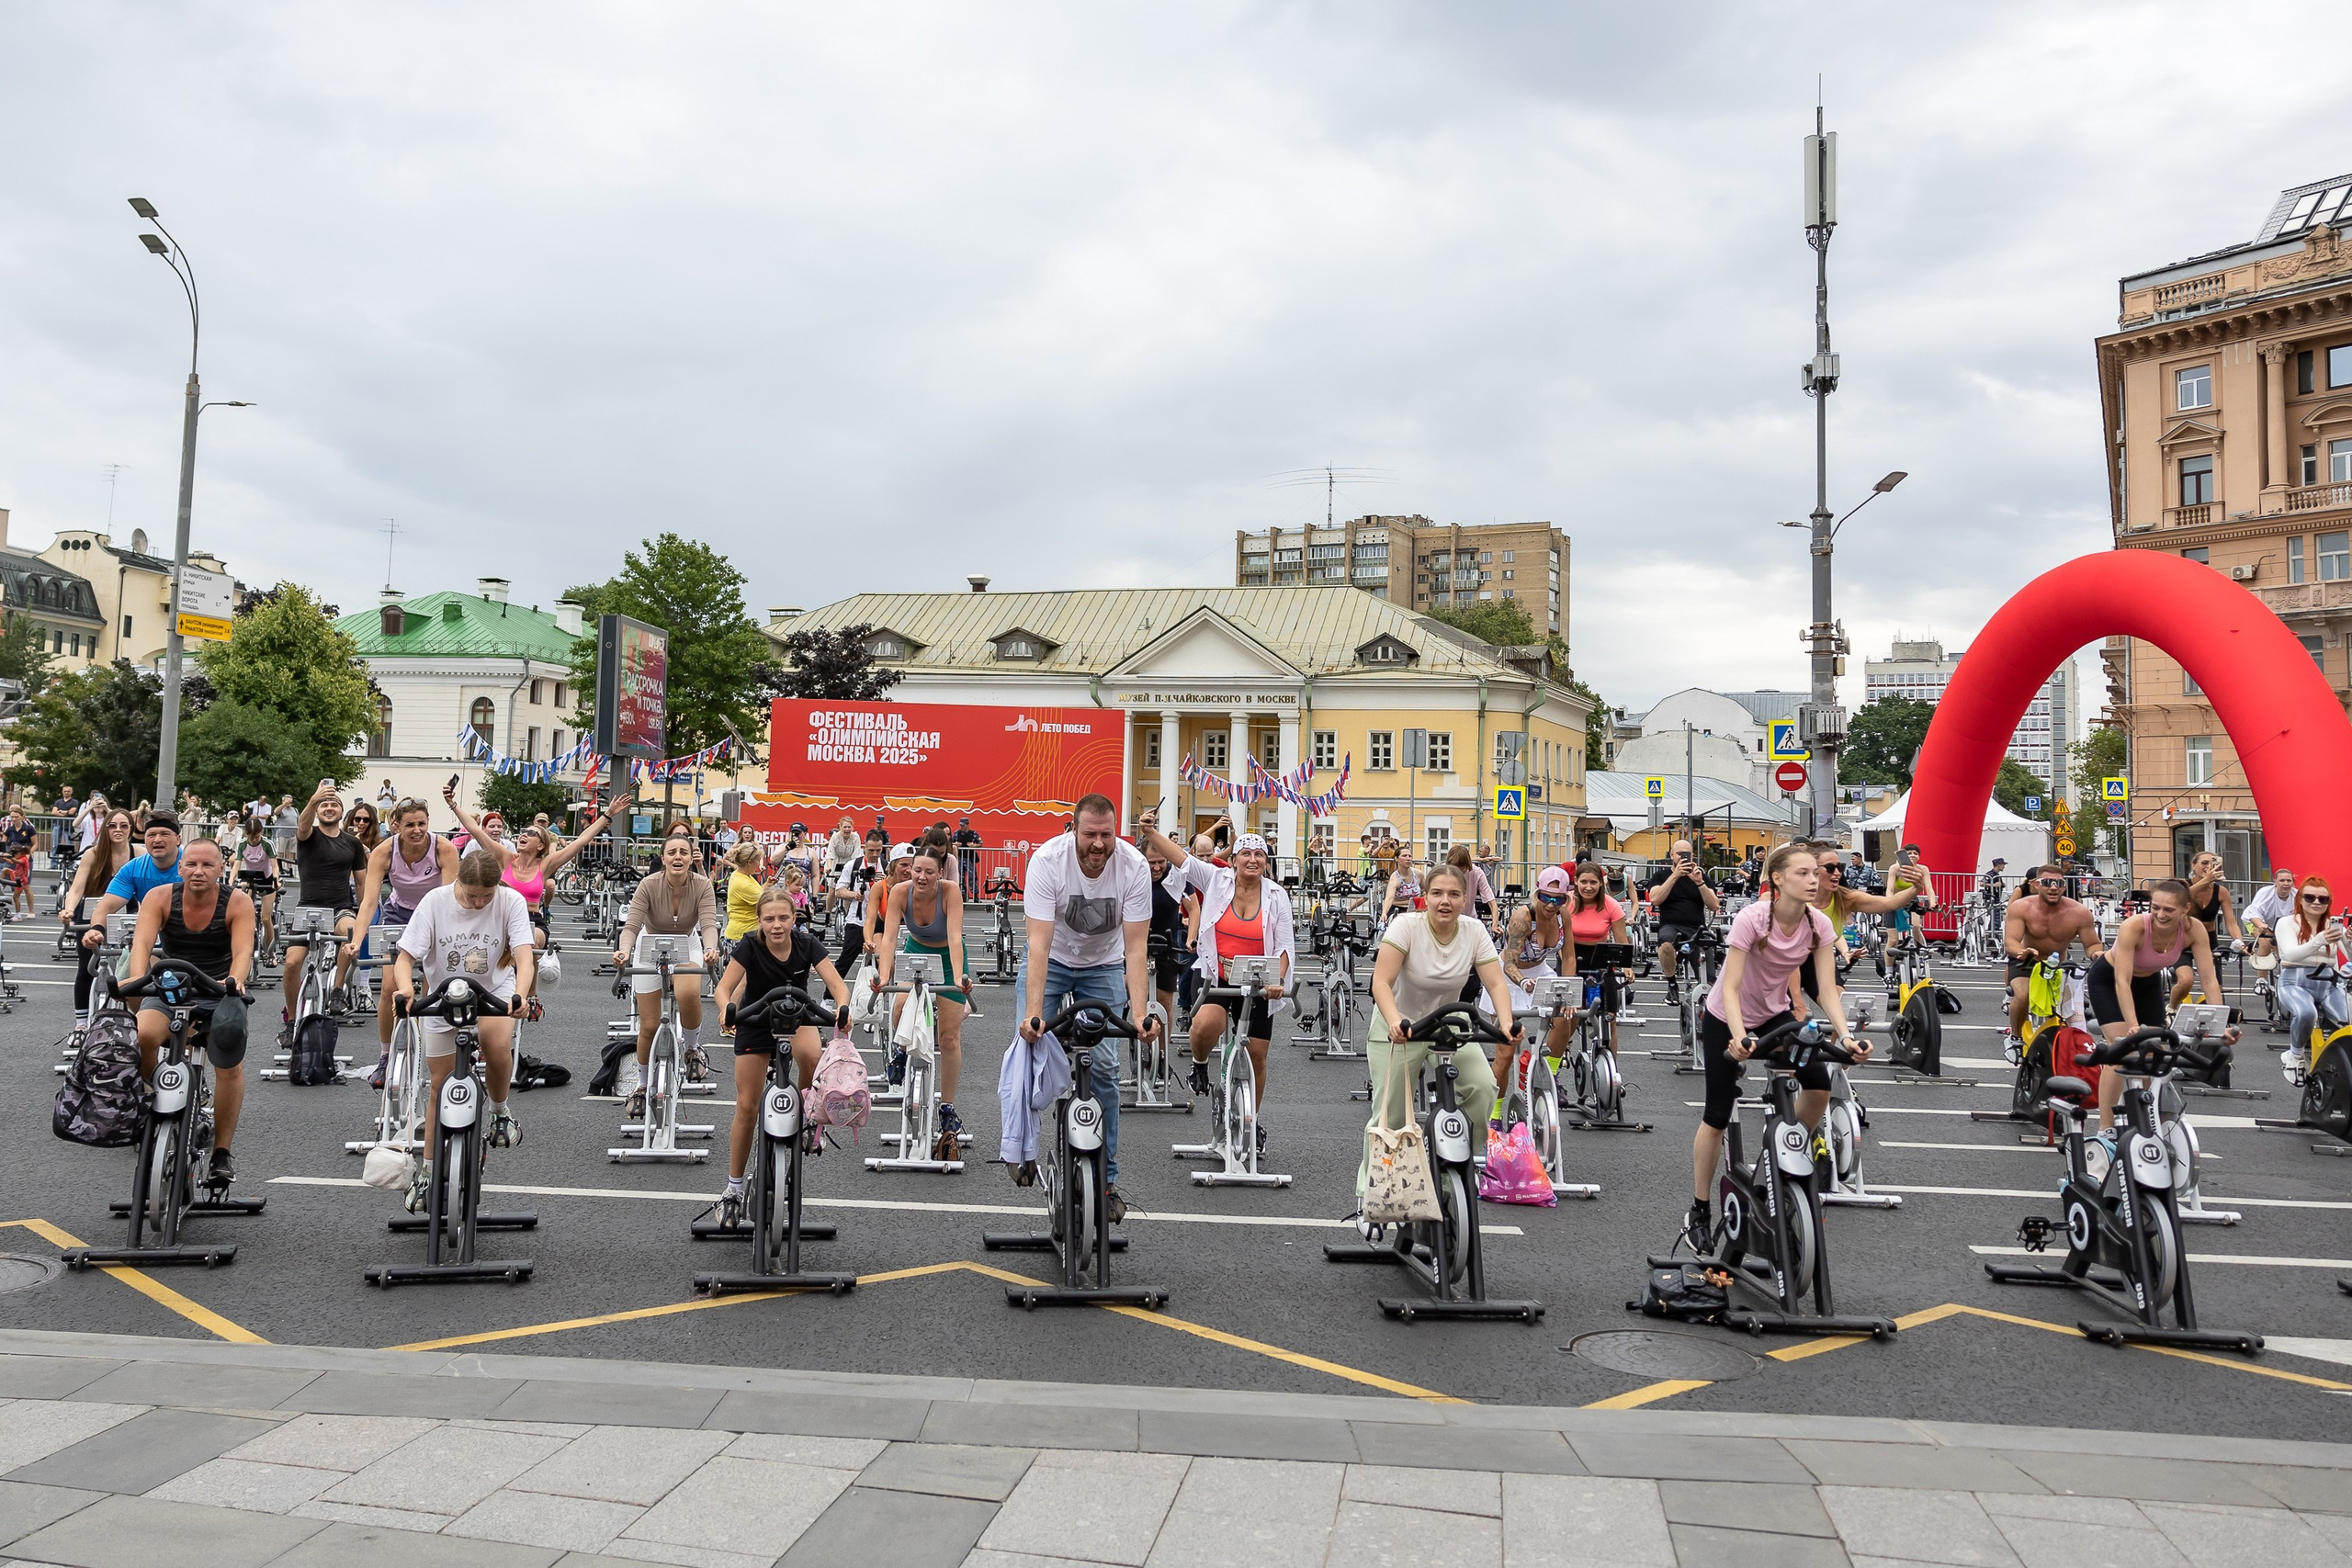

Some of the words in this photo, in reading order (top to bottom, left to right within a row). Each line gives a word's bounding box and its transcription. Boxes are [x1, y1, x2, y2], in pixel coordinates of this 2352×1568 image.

[188, 573, 212, 581] НИКИТСКАЯ
[182, 590, 206, 598] НИКИТСКИЕ
[627, 671, 663, 696] РАССРОЧКА
[1118, 693, 1149, 703] МУЗЕЙ
[1257, 694, 1296, 704] МОСКВЕ
[808, 711, 908, 731] ФЕСТИВАЛЬ
[1040, 723, 1062, 733] ЛЕТО
[1063, 723, 1091, 734] ПОБЕД
[808, 728, 941, 749] «ОЛИМПИЙСКАЯ
[807, 744, 876, 763] МОСКВА
[879, 748, 928, 765] 2025»
[2059, 843, 2072, 852] 40
[439, 932, 500, 948] SUMMER
[164, 1074, 178, 1084] GT
[451, 1088, 466, 1099] GT
[775, 1097, 789, 1108] GT
[1079, 1110, 1092, 1121] GT
[1445, 1121, 1459, 1133] GT
[1787, 1134, 1801, 1145] GT
[2143, 1145, 2158, 1158] GT
[1763, 1148, 1777, 1217] GYMTOUCH
[2116, 1159, 2133, 1228] GYMTOUCH
